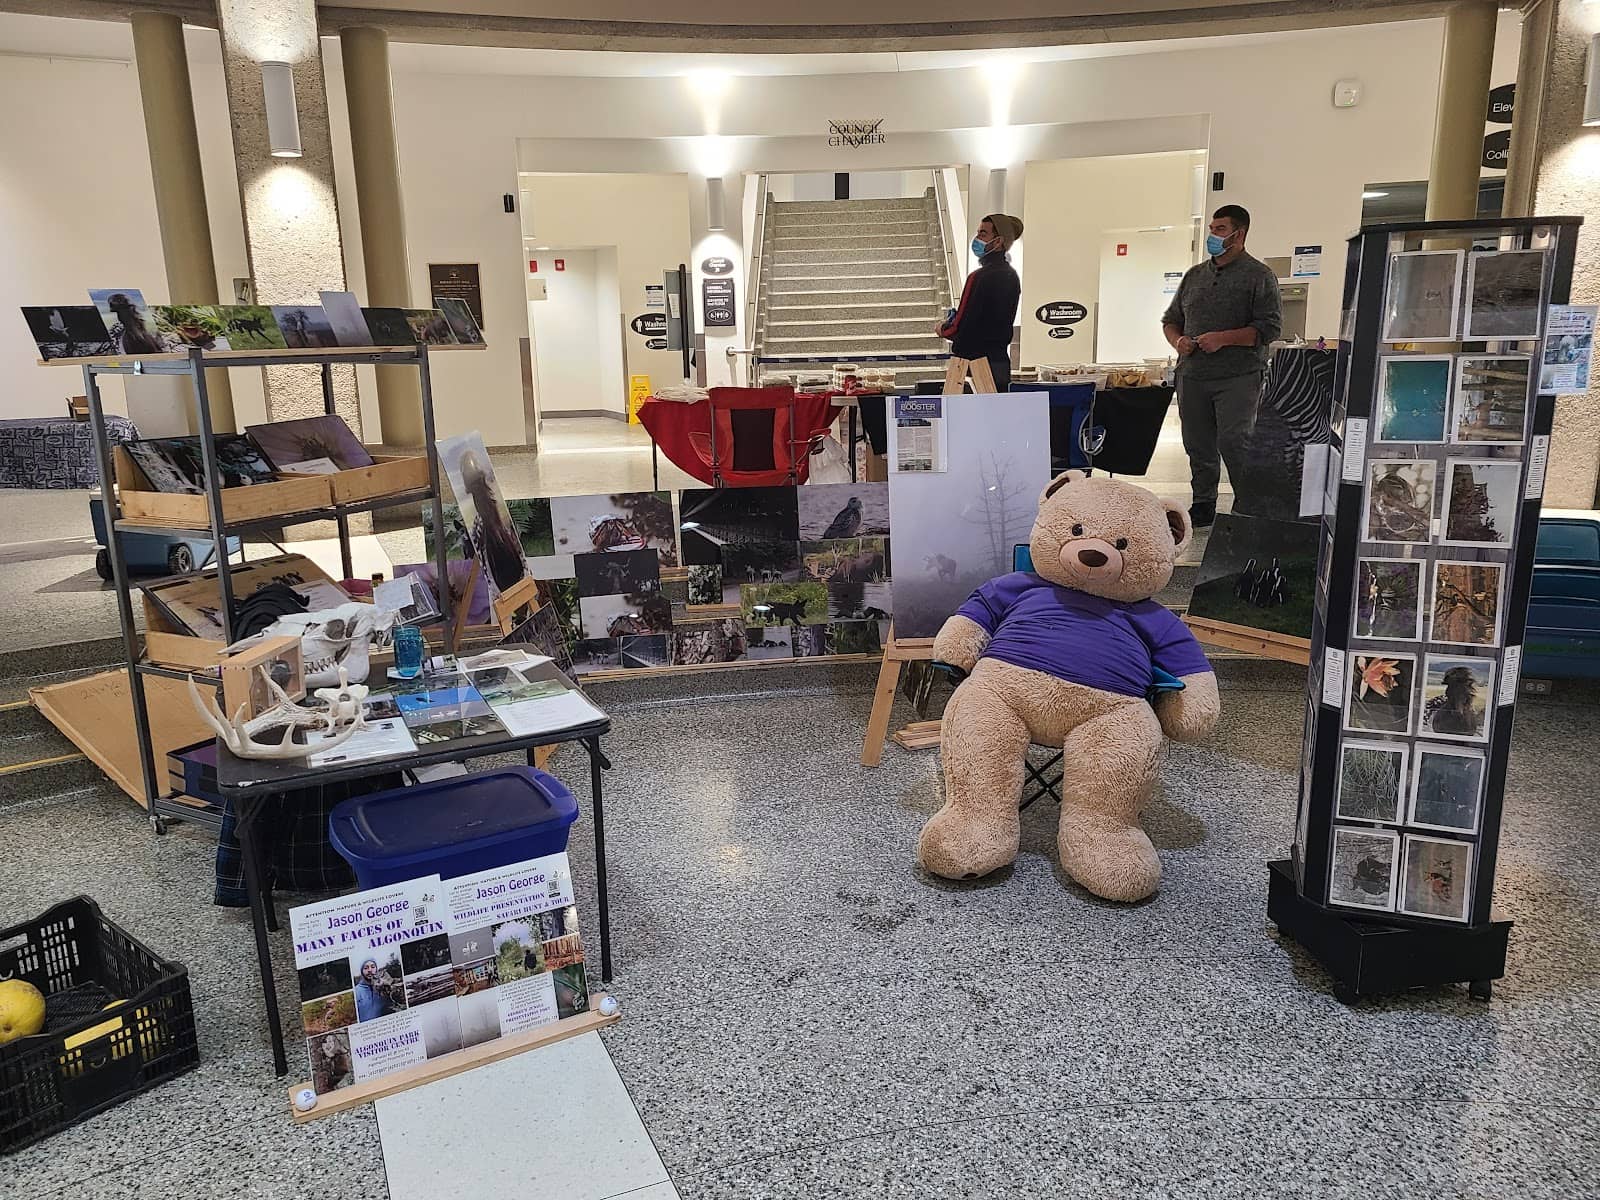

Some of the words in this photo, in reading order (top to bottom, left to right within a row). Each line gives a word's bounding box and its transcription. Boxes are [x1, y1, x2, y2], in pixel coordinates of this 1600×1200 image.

[828, 133, 886, 147] CHAMBER
[829, 124, 881, 135] COUNCIL
[900, 403, 936, 411] BOOSTER
[476, 884, 506, 900] Jason
[508, 873, 546, 890] George
[327, 912, 363, 930] Jason
[366, 900, 410, 919] George
[453, 904, 490, 921] WILDLIFE
[491, 892, 546, 913] PRESENTATION
[496, 907, 522, 920] SAFARI
[296, 935, 336, 954] MANY
[341, 923, 382, 943] FACES
[386, 918, 404, 930] OF
[368, 920, 444, 949] ALGONQUIN
[355, 1037, 397, 1055] ALGONQUIN
[399, 1030, 420, 1041] PARK
[357, 1045, 390, 1059] VISITOR
[391, 1037, 420, 1049] CENTRE
